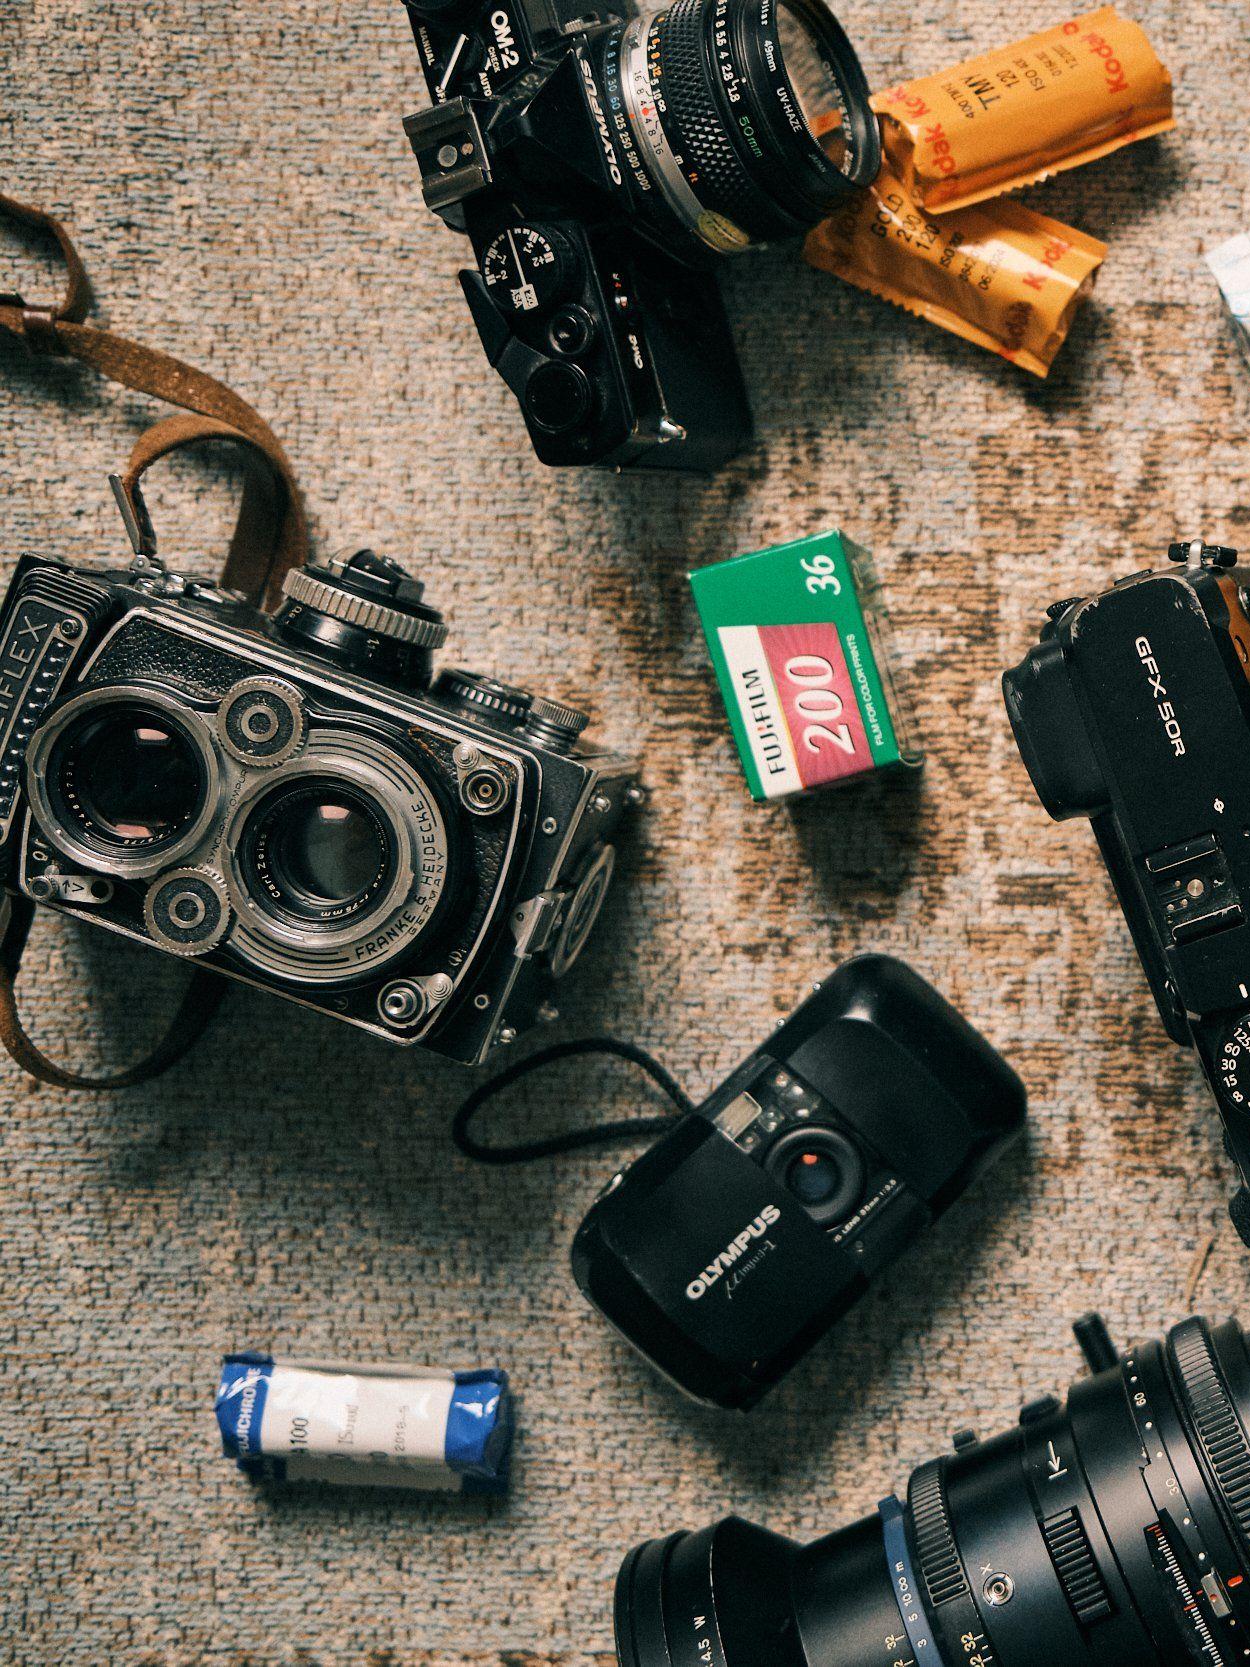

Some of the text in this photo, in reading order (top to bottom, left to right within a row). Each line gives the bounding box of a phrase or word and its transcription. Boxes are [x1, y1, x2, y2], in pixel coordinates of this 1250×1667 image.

[418, 26, 435, 66] MANUAL
[491, 10, 520, 69] OM-2
[719, 51, 729, 60] 4
[488, 46, 501, 73] CHECK
[997, 70, 1020, 88] 120
[478, 72, 492, 97] AUTO
[653, 89, 662, 100] 10
[764, 39, 777, 72] 49mm
[776, 87, 803, 133] UV-HAZE
[963, 73, 1001, 111] TMY
[1025, 69, 1046, 91] ISO
[580, 59, 622, 186] OLYMPUS
[606, 63, 651, 191] 15 30 60 125 250 500 1000
[634, 70, 664, 155] 16 16
[958, 100, 975, 119] 400
[739, 115, 763, 158] 50mm
[925, 123, 956, 174] dak
[871, 194, 904, 239] GOLD
[897, 214, 922, 242] 200
[916, 223, 941, 251] 120
[510, 288, 522, 309] ASA
[800, 554, 841, 596] 36
[786, 654, 855, 754] 200
[847, 634, 884, 745] FILM FOR COLOR PRINTS
[1135, 636, 1186, 757] GFX 50R
[742, 669, 786, 774] FUJIFILM
[257, 833, 281, 898] Carl Zeiss
[356, 801, 436, 959] FRANKE HEIDECKE
[409, 852, 444, 935] GERMANY
[1221, 1059, 1236, 1070] 30
[1224, 1042, 1240, 1056] 60
[1223, 1074, 1237, 1087] 15
[1232, 1091, 1243, 1102] 8
[686, 1204, 781, 1299] OLYMPUS
[1133, 1392, 1147, 1407] 60
[1165, 1477, 1180, 1496] 30
[902, 1593, 928, 1649] 10 3
[885, 1634, 897, 1650] 32
[961, 1632, 977, 1652] 32
